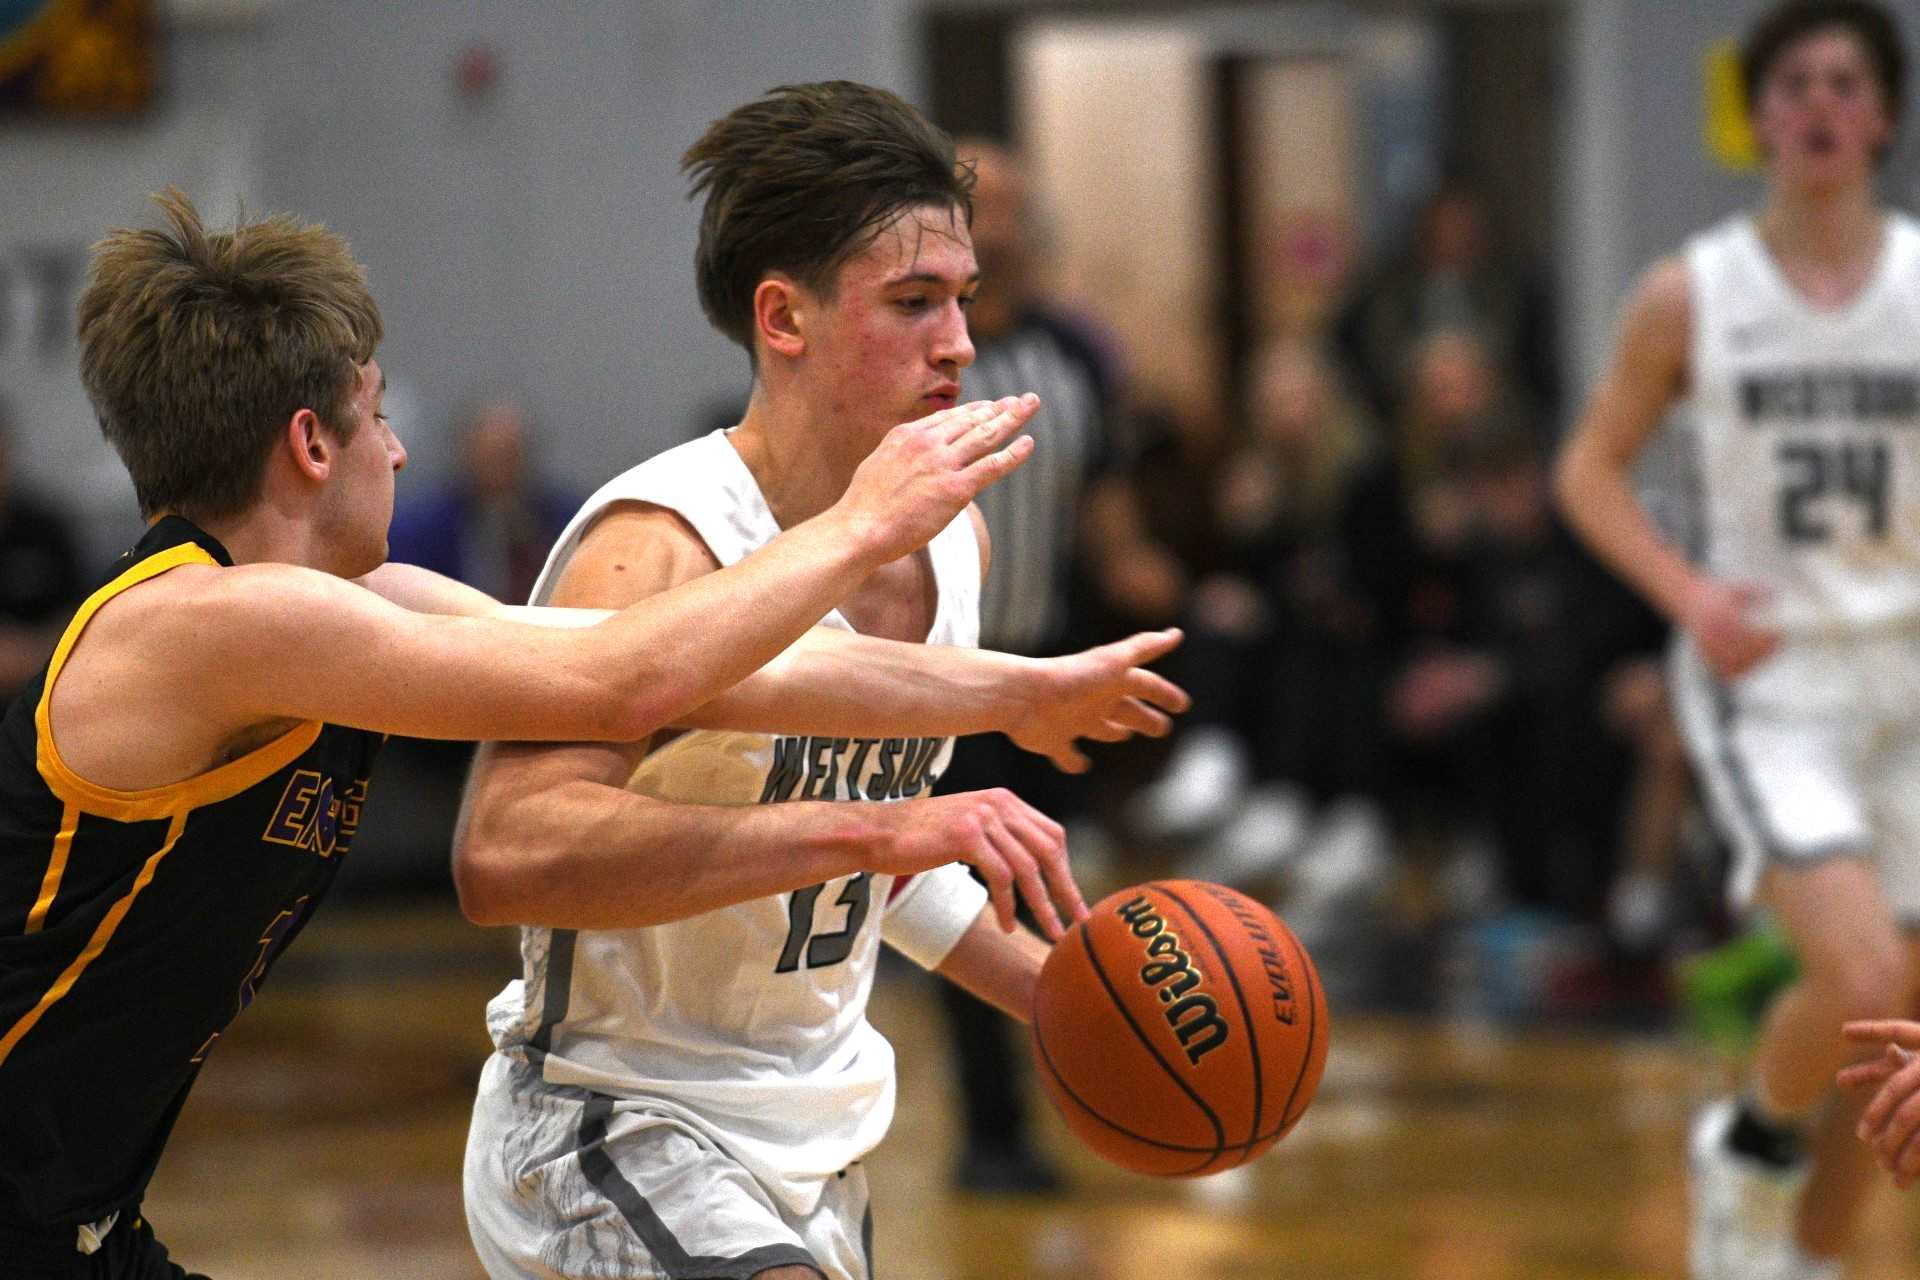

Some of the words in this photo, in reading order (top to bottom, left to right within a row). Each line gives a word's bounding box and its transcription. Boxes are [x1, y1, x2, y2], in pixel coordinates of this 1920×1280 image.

[1777, 441, 1888, 544] 24
[760, 736, 948, 804] WESTSID
[774, 871, 874, 973] 13
[1116, 896, 1230, 1067] Wilson
